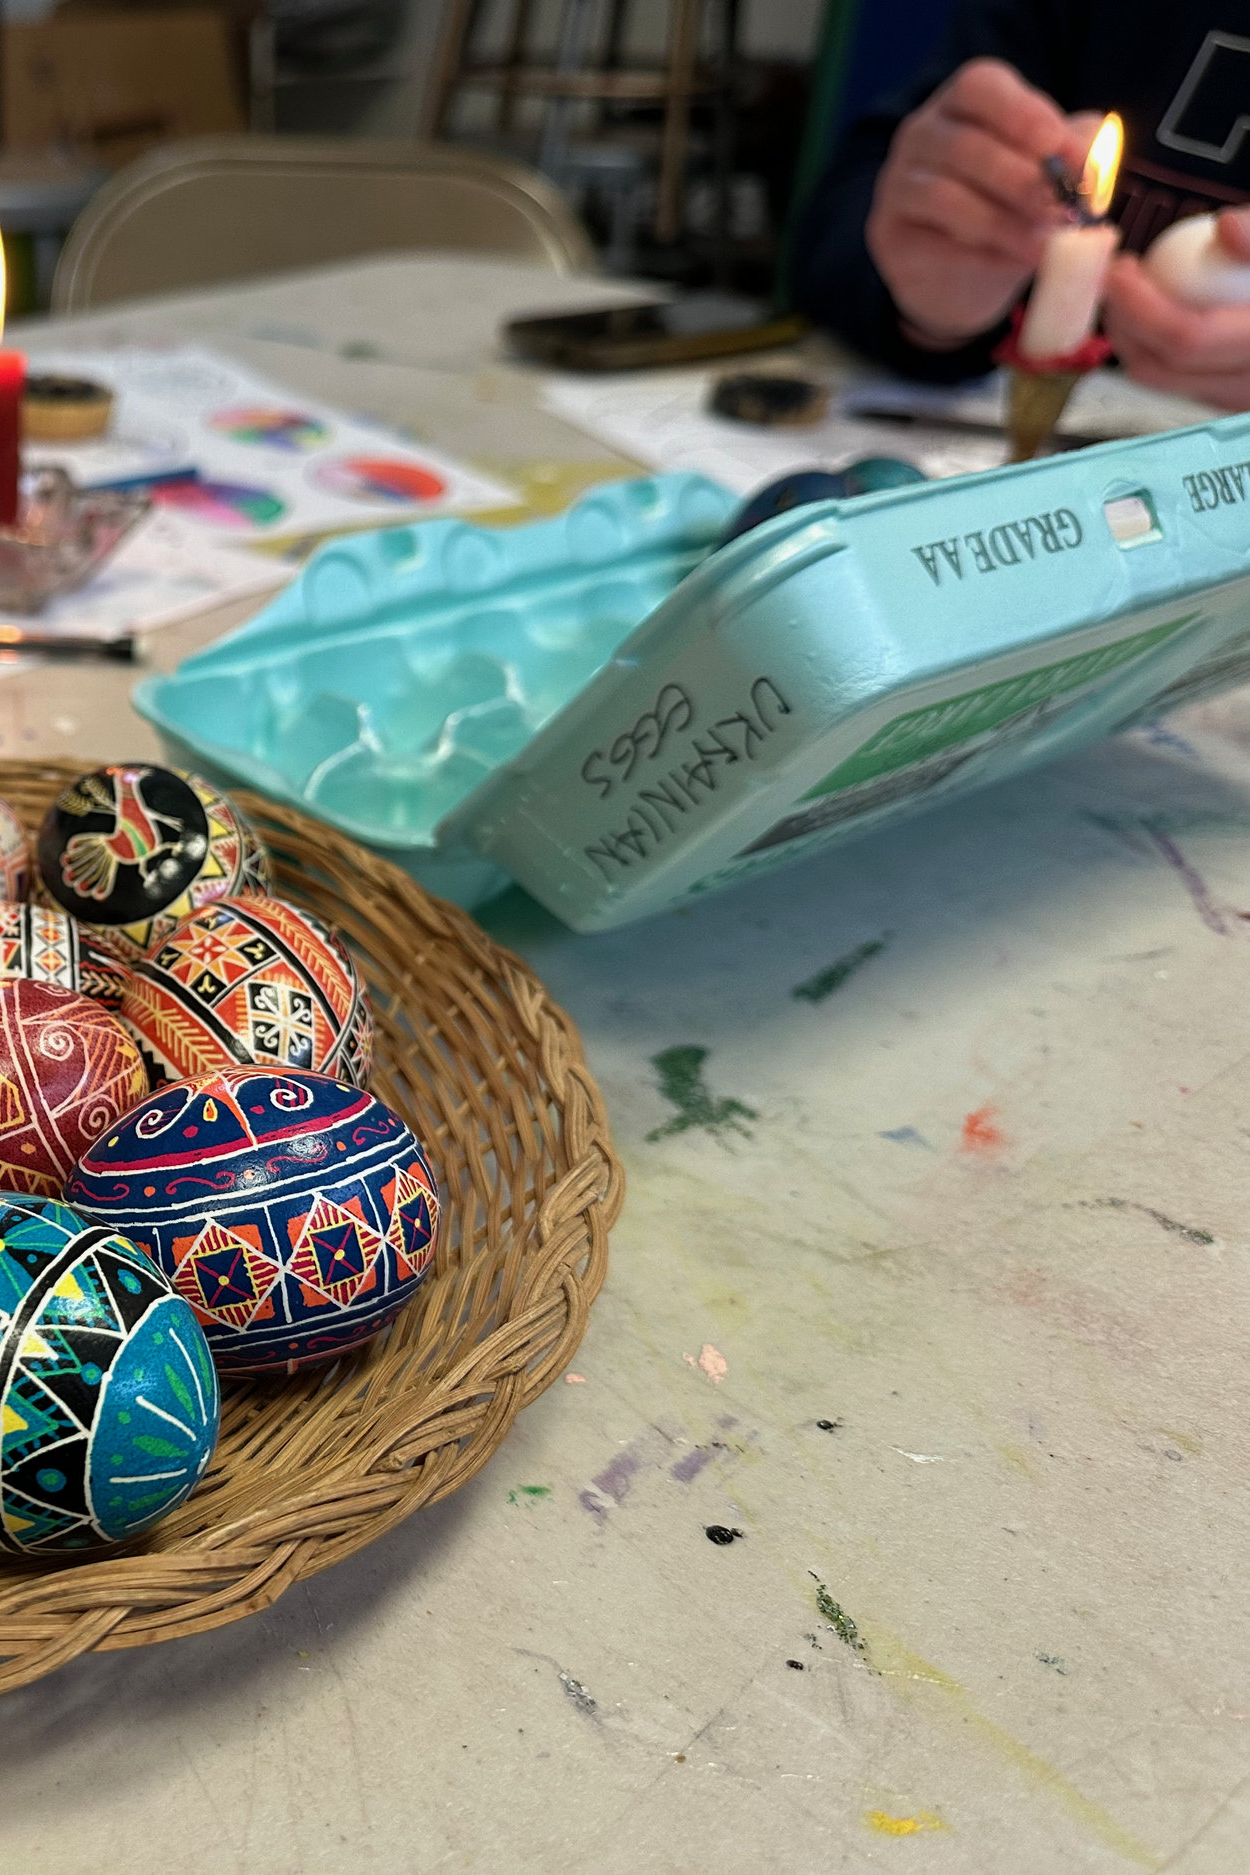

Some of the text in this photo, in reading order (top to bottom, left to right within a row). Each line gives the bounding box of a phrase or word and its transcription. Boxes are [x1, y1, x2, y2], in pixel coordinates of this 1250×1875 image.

[1182, 460, 1250, 512] ARGE
[910, 507, 1084, 587] GRADE AA
[580, 683, 692, 798] EGGS
[583, 676, 792, 883] UKRAINIAN
